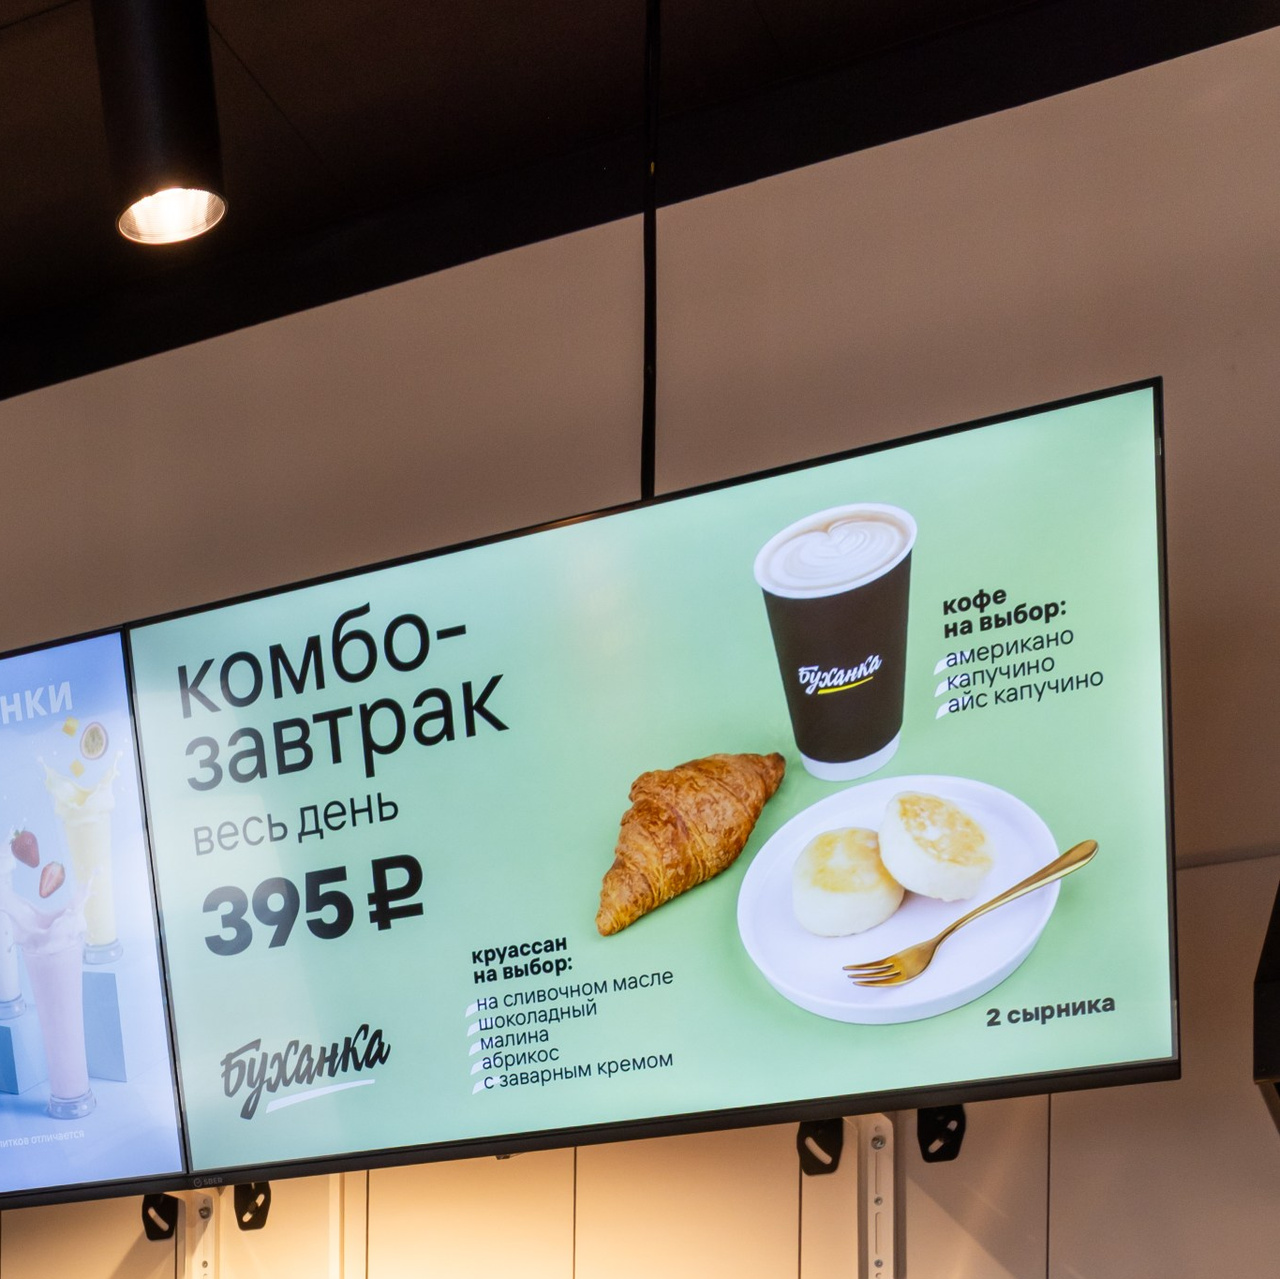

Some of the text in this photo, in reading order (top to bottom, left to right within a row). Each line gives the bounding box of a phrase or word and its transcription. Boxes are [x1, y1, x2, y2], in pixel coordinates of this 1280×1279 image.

[943, 587, 1007, 617] кофе
[943, 599, 1067, 639] на выбор:
[178, 602, 467, 719] комбо-
[946, 628, 1074, 668] американо
[798, 654, 883, 696] Буханка
[946, 653, 1055, 690] капучино
[948, 669, 1104, 714] айс капучино
[185, 674, 509, 791] завтрак
[193, 791, 400, 855] весь день
[202, 865, 355, 956] 395
[472, 937, 568, 966] круассан
[473, 957, 573, 984] на выбор:
[477, 970, 673, 1011] на сливочном масле
[479, 999, 597, 1031] шоколадный
[986, 996, 1116, 1028] 2 сырника
[480, 1029, 549, 1050] малина
[220, 1023, 392, 1120] Буханка
[482, 1048, 559, 1071] абрикос
[484, 1053, 673, 1089] с заварным кремом
[31, 1129, 84, 1144] отличается
